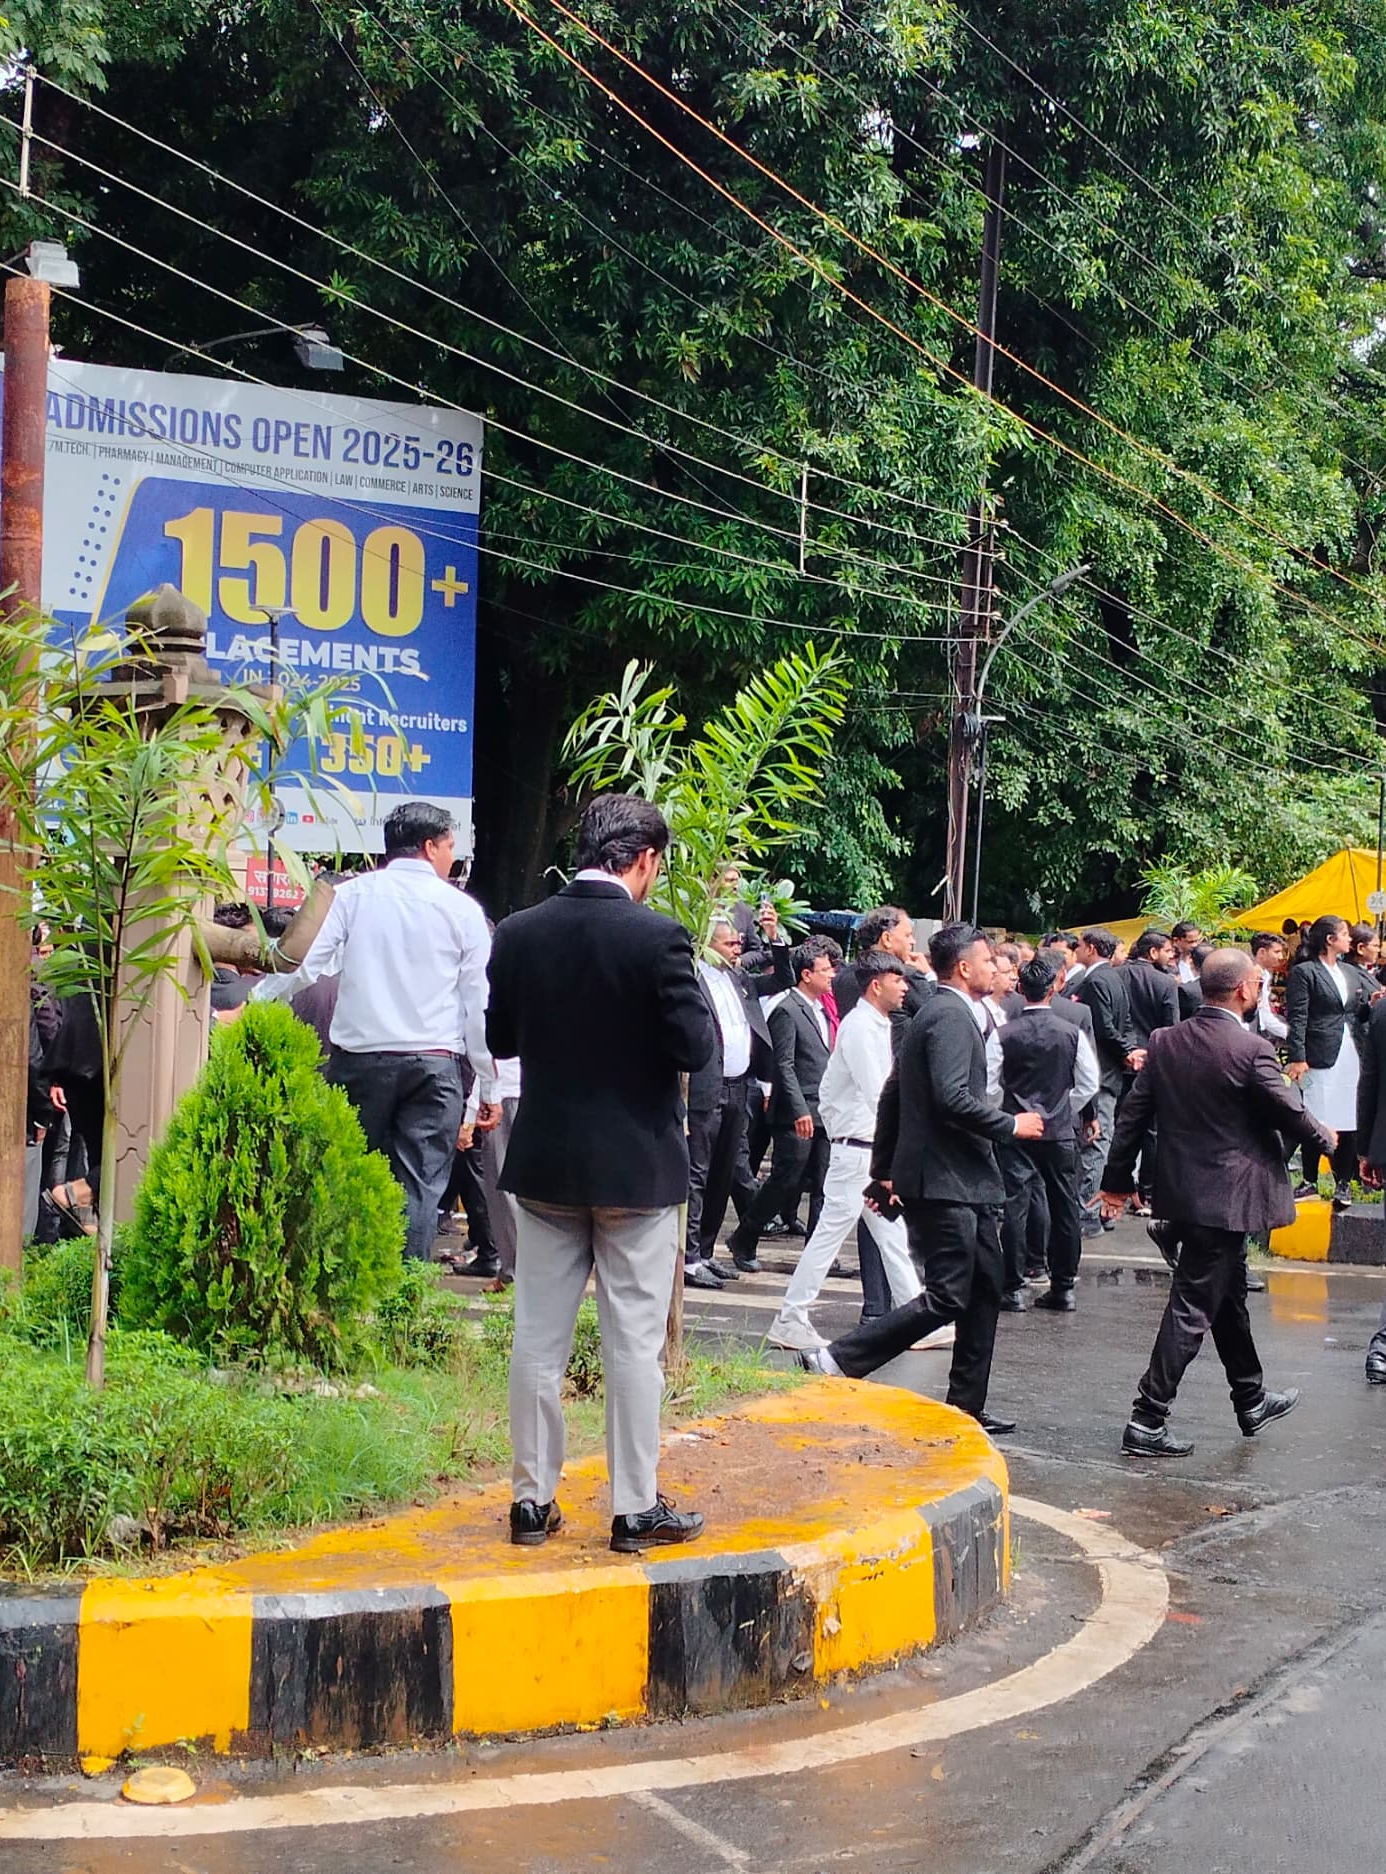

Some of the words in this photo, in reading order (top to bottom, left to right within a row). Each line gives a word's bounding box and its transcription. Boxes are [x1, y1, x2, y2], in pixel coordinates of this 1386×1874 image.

[46, 391, 242, 450] ADMISSIONS
[253, 417, 332, 460] OPEN
[343, 428, 474, 477] 2025-26
[99, 446, 149, 463] PHARMACY
[156, 453, 218, 472] MANAGEMENT
[225, 463, 272, 478] COMPUTER
[273, 465, 328, 483] APPLICATION
[335, 475, 353, 486] LAW
[360, 477, 406, 493] COMMERCE
[413, 483, 434, 496] ARTS
[440, 487, 473, 500] SCIENCE
[206, 631, 421, 675] LACEMENTS
